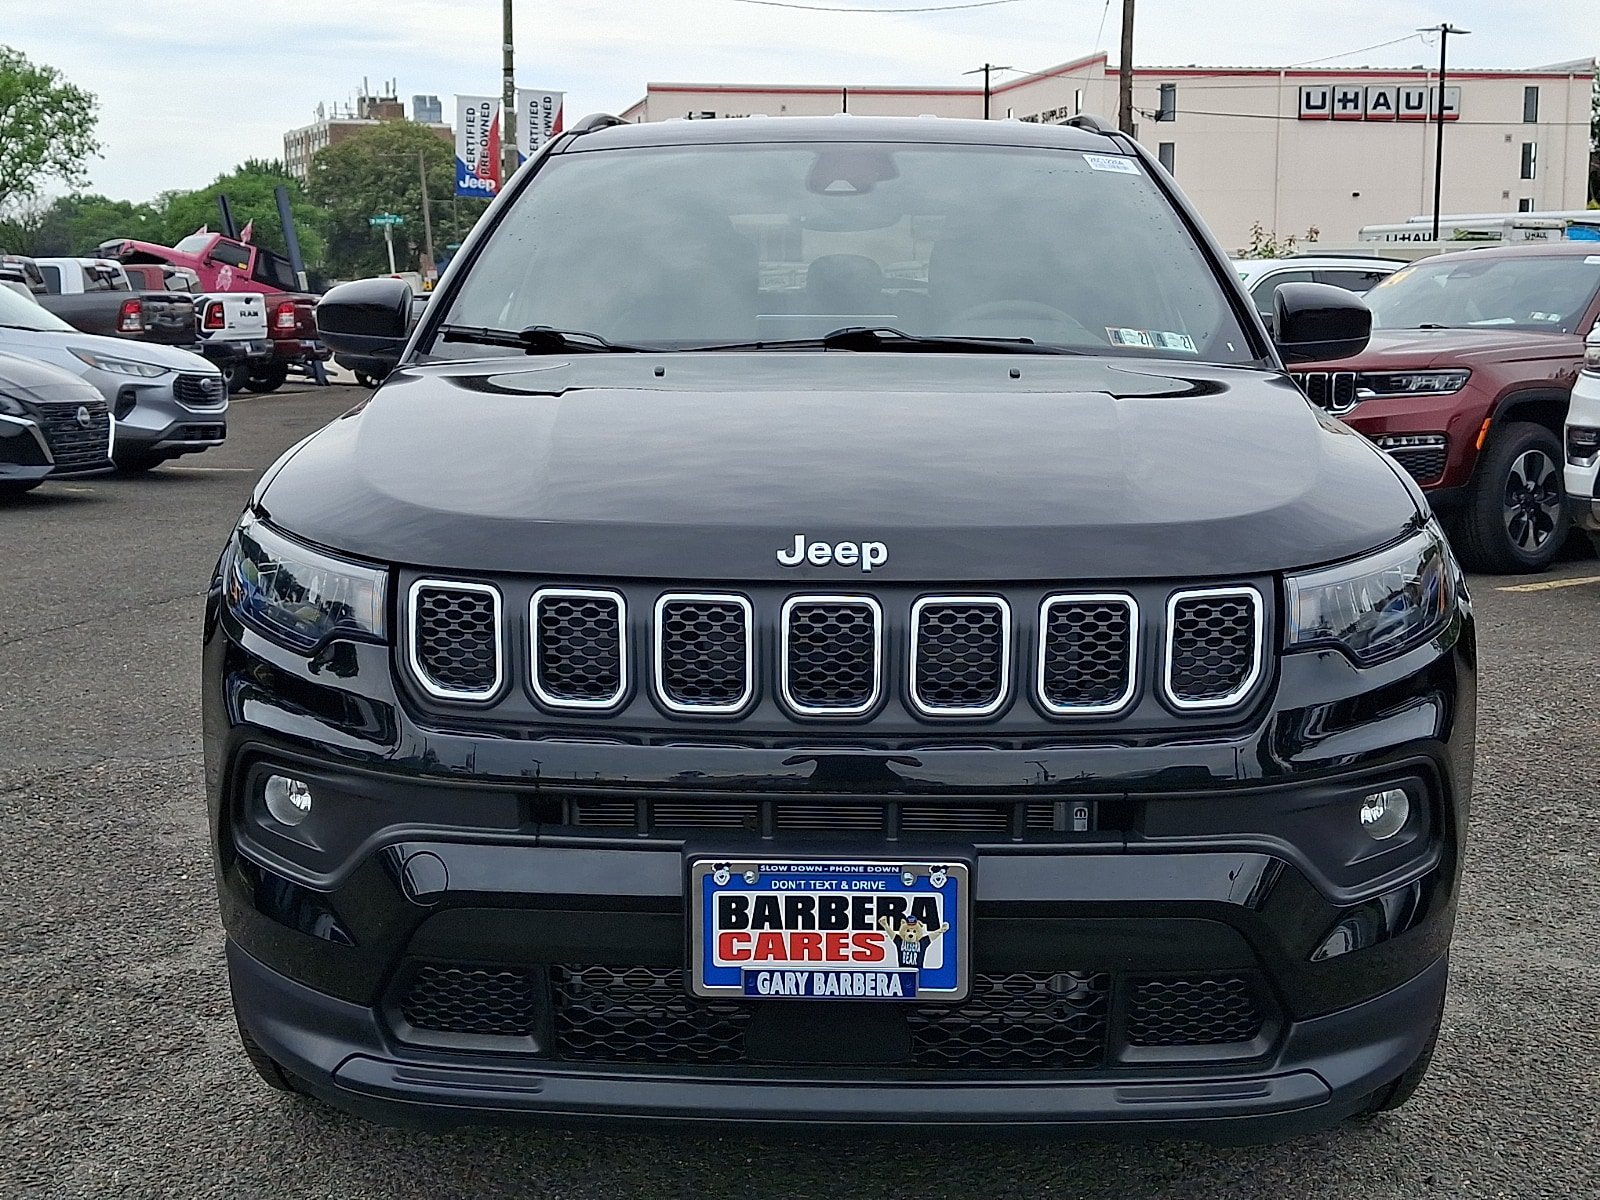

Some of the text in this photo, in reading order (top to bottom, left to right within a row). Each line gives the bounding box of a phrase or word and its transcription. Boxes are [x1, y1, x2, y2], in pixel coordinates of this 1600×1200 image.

[1041, 105, 1068, 123] SUPPLIES
[466, 107, 476, 172] CERTIFIED
[529, 100, 539, 156] ERTIFIED
[459, 175, 496, 191] Jeep
[240, 310, 259, 318] RAM
[776, 534, 889, 573] Jeep
[771, 880, 887, 890] DON'T TEXT & DRIVE
[718, 895, 941, 931] BARBERA
[718, 932, 886, 961] CARES
[902, 951, 918, 966] BEAR
[756, 971, 903, 997] GARY BARBERA
